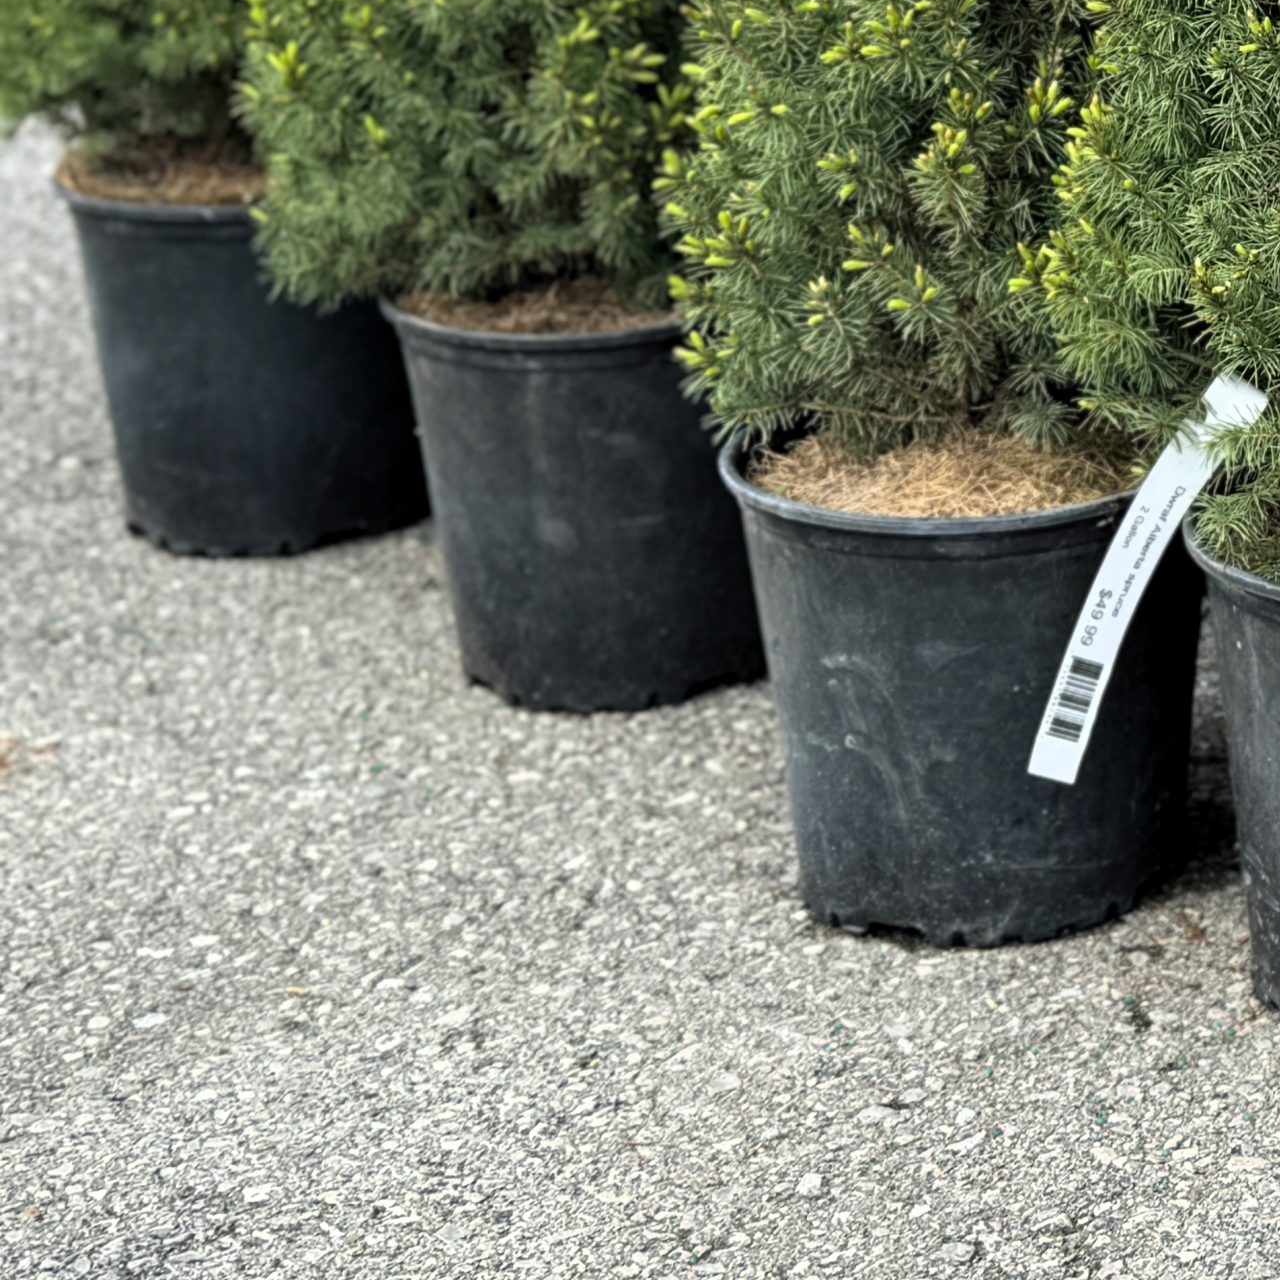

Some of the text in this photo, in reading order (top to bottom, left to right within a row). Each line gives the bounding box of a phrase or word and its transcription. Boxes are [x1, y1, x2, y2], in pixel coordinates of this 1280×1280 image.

[1112, 486, 1186, 617] Dwraf Alberta spruce
[1122, 505, 1150, 549] 2 Gallon
